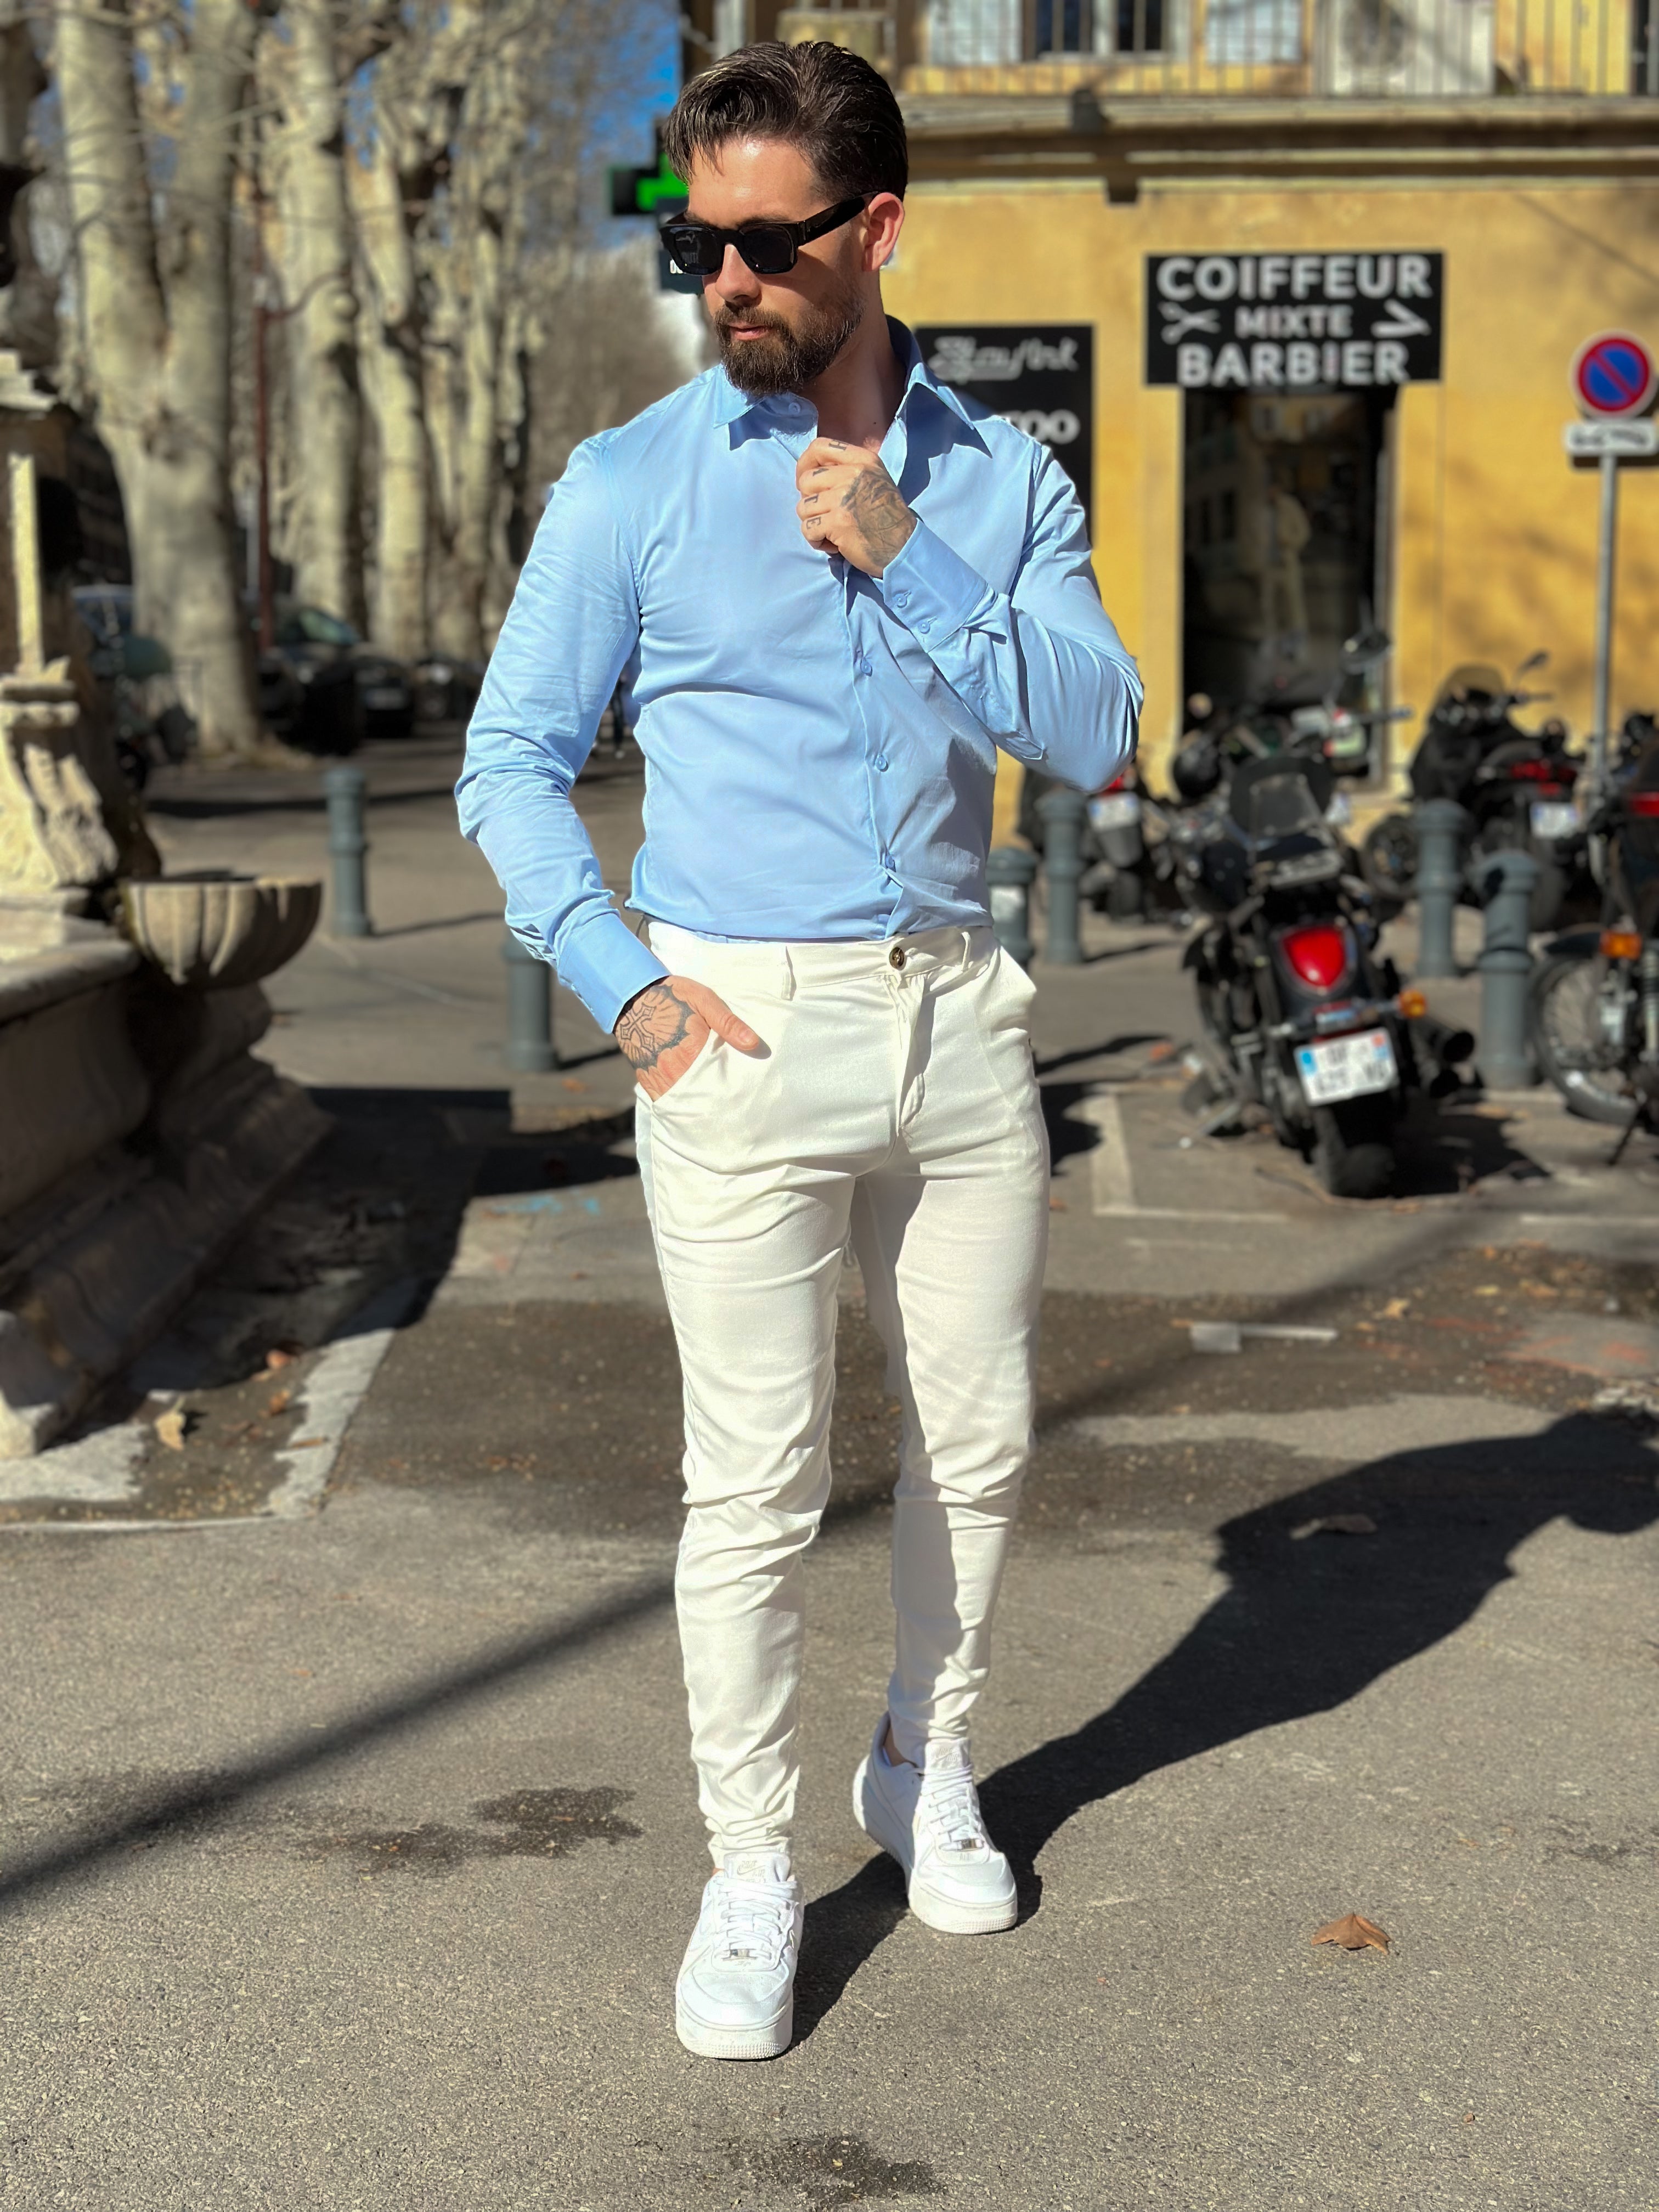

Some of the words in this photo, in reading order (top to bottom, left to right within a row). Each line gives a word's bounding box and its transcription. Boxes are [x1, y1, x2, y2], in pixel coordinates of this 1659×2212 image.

[1156, 255, 1433, 300] COIFFEUR
[1234, 304, 1353, 338] MIXTE
[1177, 341, 1410, 386] BARBIER
